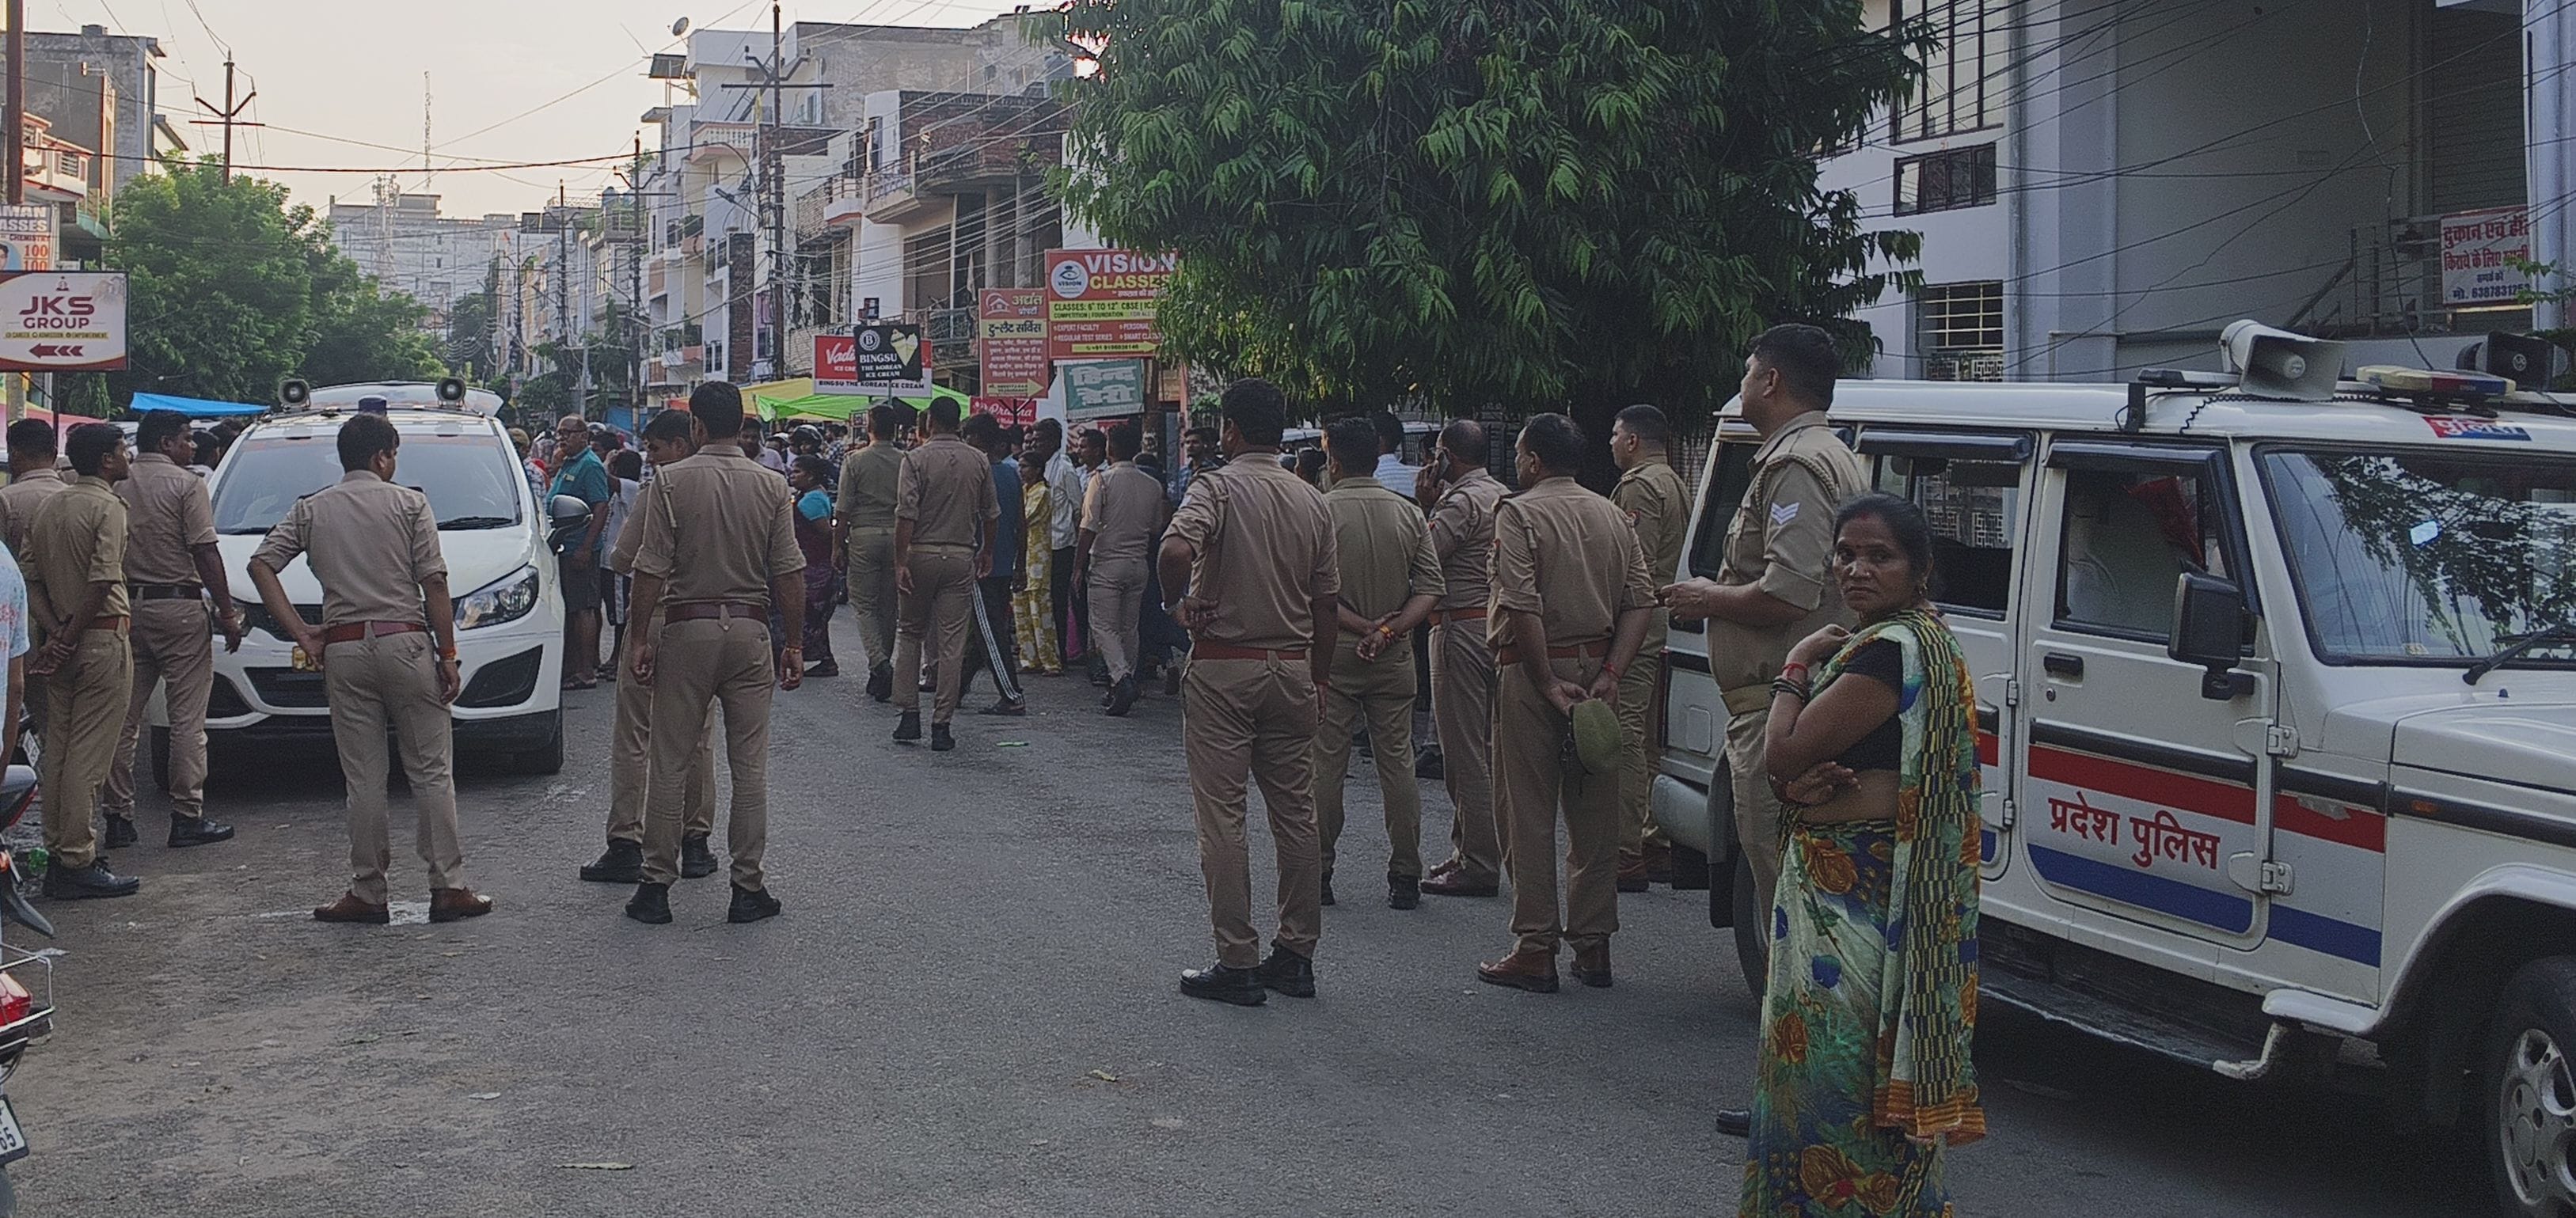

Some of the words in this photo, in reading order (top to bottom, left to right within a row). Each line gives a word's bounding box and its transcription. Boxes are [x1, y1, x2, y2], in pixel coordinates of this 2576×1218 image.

[0, 205, 47, 218] MAN
[0, 218, 47, 232] ASSES
[2444, 224, 2482, 249] दुकान
[25, 245, 47, 257] 100
[24, 260, 47, 271] 100
[1085, 252, 1176, 274] VISION
[2444, 249, 2471, 271] किराये
[2471, 249, 2482, 268] के
[2483, 248, 2502, 268] लिए
[19, 296, 95, 315] JKS
[23, 317, 89, 329] GROUP
[826, 342, 856, 365] Vadi
[860, 354, 898, 364] BINGSU
[2048, 791, 2120, 845] प्रदेश
[2130, 810, 2221, 870] पुलिस
